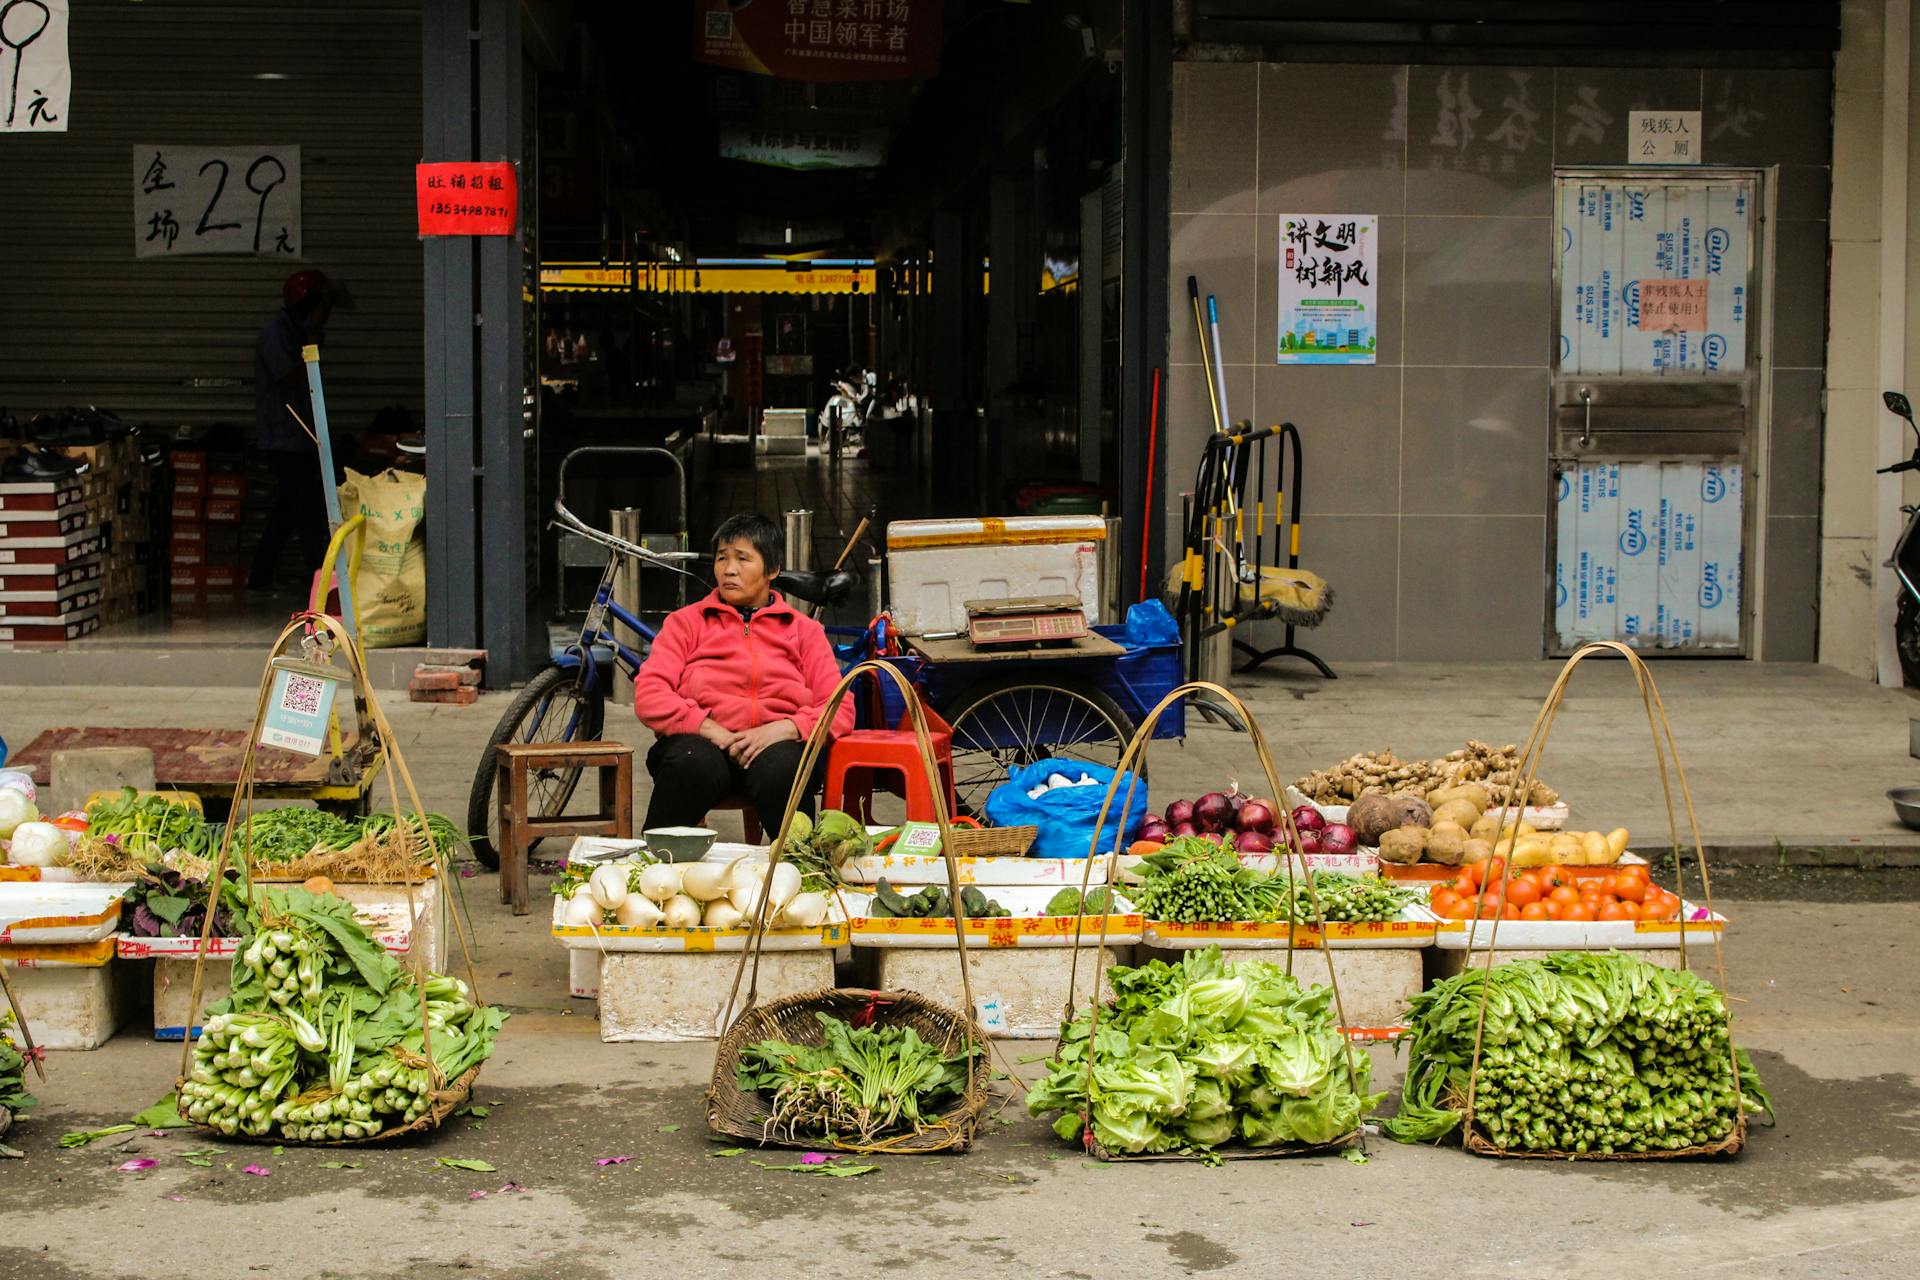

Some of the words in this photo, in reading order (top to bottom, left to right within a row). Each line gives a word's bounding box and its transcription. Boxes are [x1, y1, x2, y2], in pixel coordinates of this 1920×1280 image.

[784, 19, 909, 49] 中国领军者
[1640, 118, 1689, 134] 残疾人
[427, 174, 505, 190] 旺铺招租
[1286, 218, 1357, 257] 讲文明
[1665, 232, 1673, 252] SUS
[1665, 254, 1673, 271] 304
[1294, 256, 1369, 297] 树新风
[1586, 285, 1594, 305] SUS
